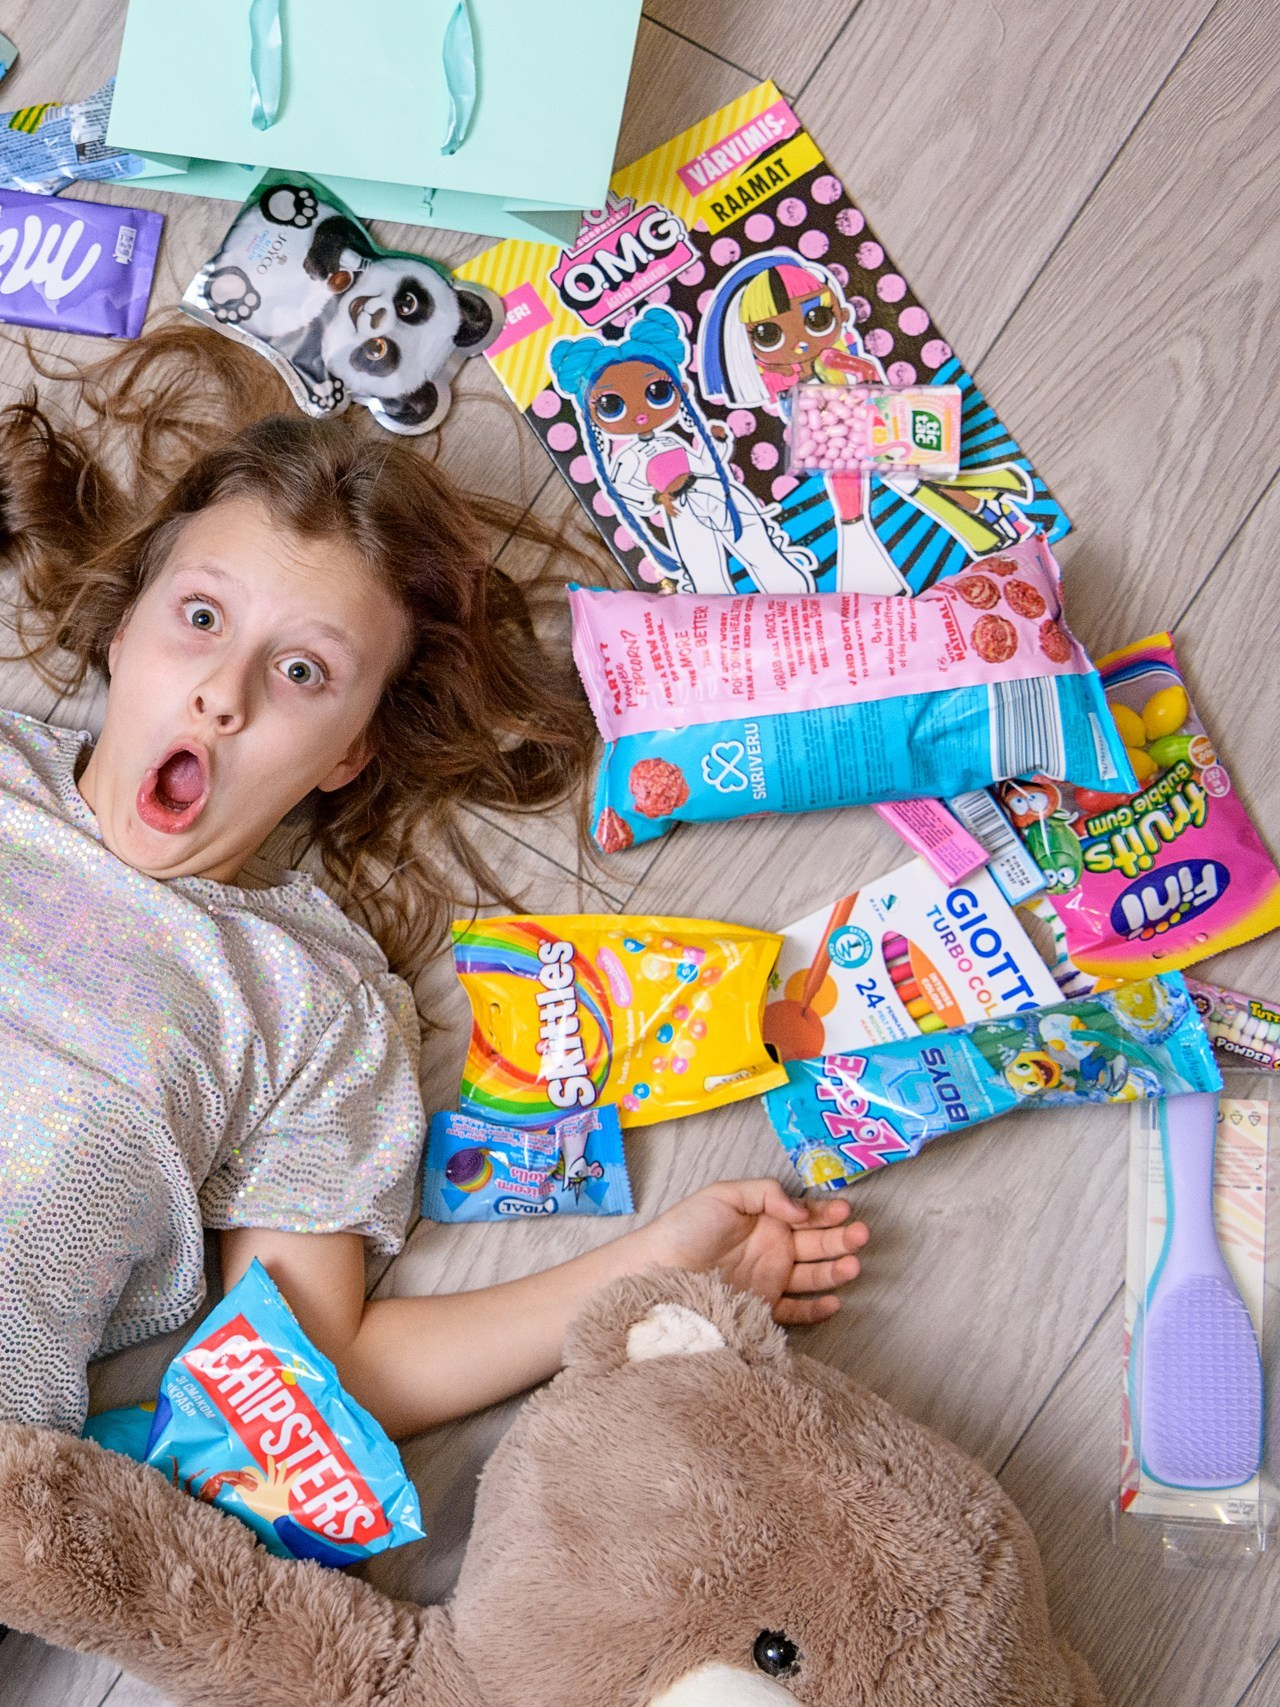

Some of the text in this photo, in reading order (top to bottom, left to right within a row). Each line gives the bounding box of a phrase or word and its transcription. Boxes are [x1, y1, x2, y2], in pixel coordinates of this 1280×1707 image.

[688, 112, 789, 188] VÄRVIMIS-
[710, 159, 793, 223] RAAMAT
[257, 233, 287, 275] JOYCO
[915, 415, 929, 444] tac
[926, 421, 941, 445] tic
[644, 612, 654, 636] BAGS
[744, 613, 752, 623] OF
[802, 613, 810, 628] AND
[872, 618, 881, 629] the
[732, 634, 740, 645] IS
[743, 625, 751, 648] KIND
[871, 631, 883, 643] By
[884, 628, 894, 646] have
[908, 622, 917, 641] other
[940, 603, 966, 661] NATURAL
[646, 640, 665, 672] FEW
[675, 630, 693, 668] MORE
[858, 643, 867, 666] SHARE
[886, 648, 894, 664] also
[897, 643, 906, 657] this
[670, 670, 679, 682] OF
[846, 653, 856, 677] AND
[889, 667, 895, 676] we
[898, 660, 907, 668] of
[745, 675, 755, 701] THAN
[745, 722, 767, 801] SKRIVERU
[1134, 760, 1192, 814] Bubble
[1121, 863, 1218, 931] Fini
[926, 904, 973, 973] TURBO
[946, 888, 1040, 1012] GIOTT
[856, 978, 885, 1009] 24
[922, 977, 945, 1011] COLORS
[928, 972, 954, 1008] INTENSE
[536, 940, 597, 1108] Skittles
[1216, 1037, 1272, 1064] POWDER
[921, 1047, 970, 1123] BOYS
[503, 1202, 549, 1214] VIDAL
[183, 1383, 216, 1419] СМАКОМ
